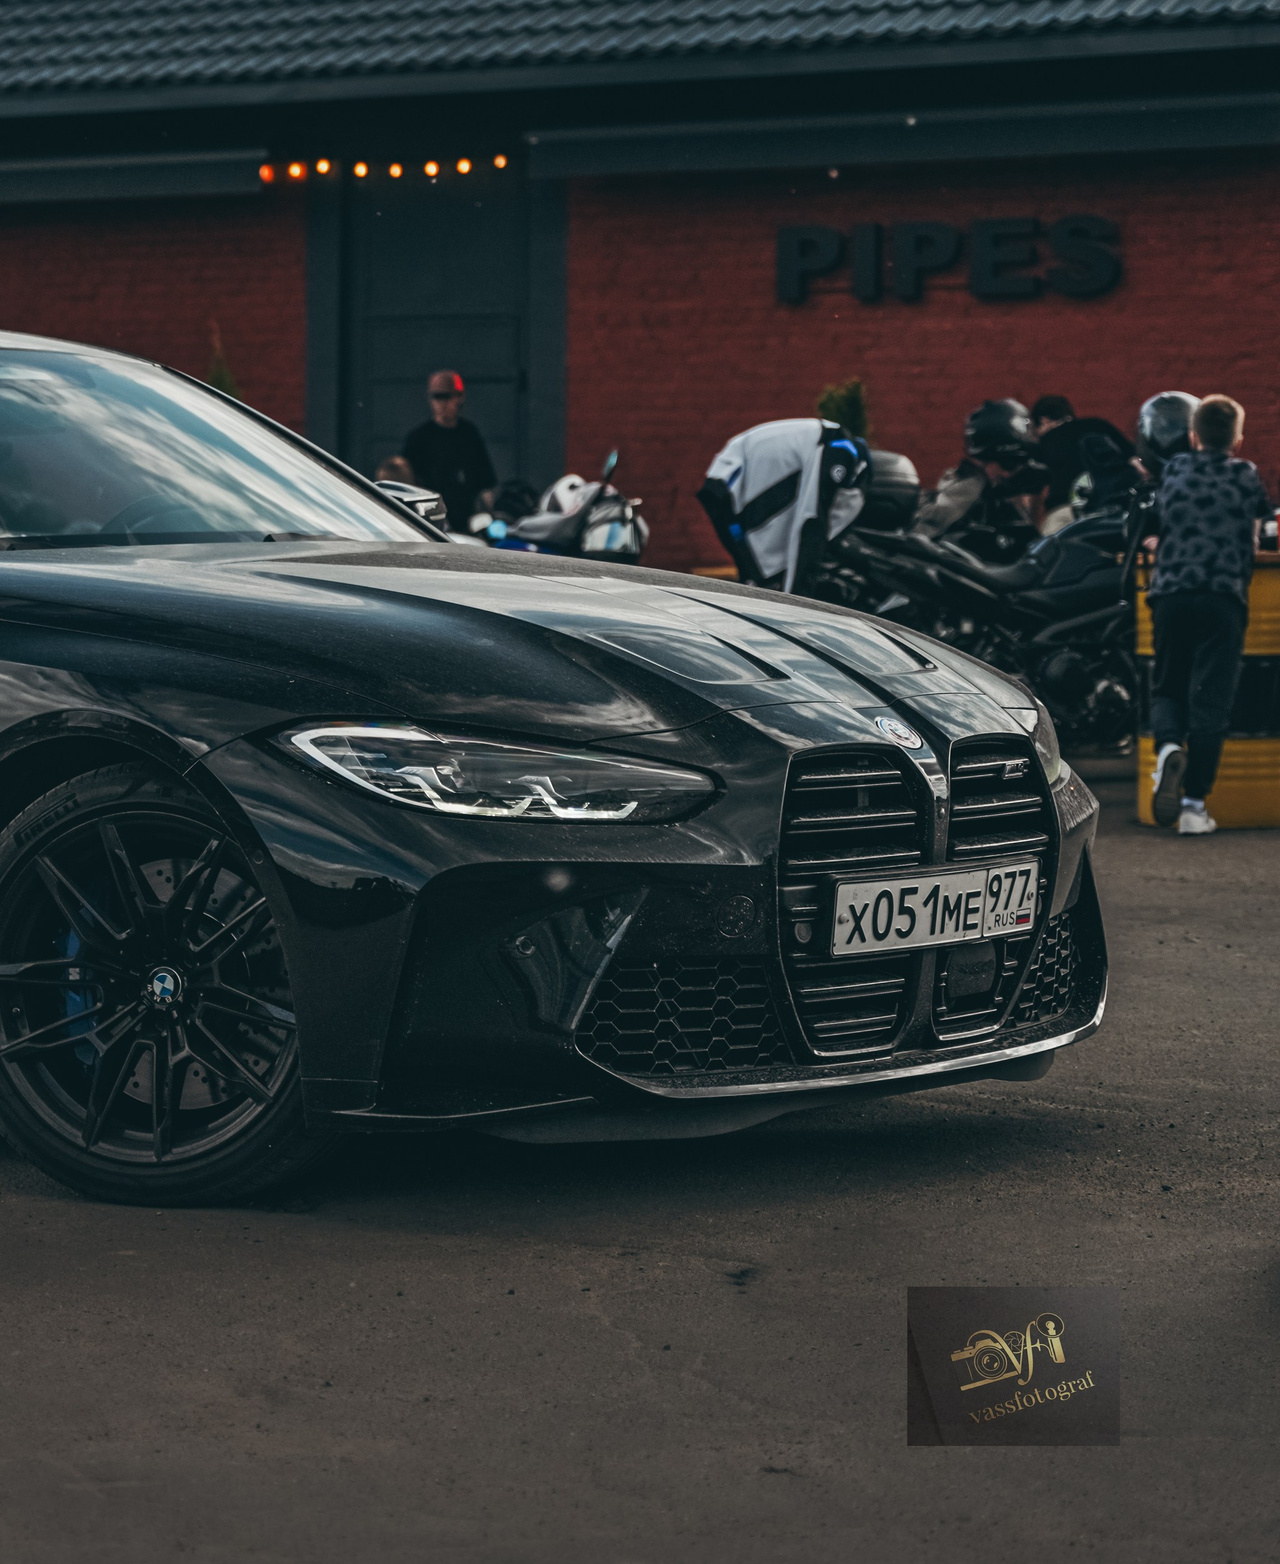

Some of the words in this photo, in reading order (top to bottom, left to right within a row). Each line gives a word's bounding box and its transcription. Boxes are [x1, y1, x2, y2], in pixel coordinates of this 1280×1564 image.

[776, 214, 1123, 305] PIPES
[988, 868, 1032, 913] 977
[993, 911, 1015, 928] RUS
